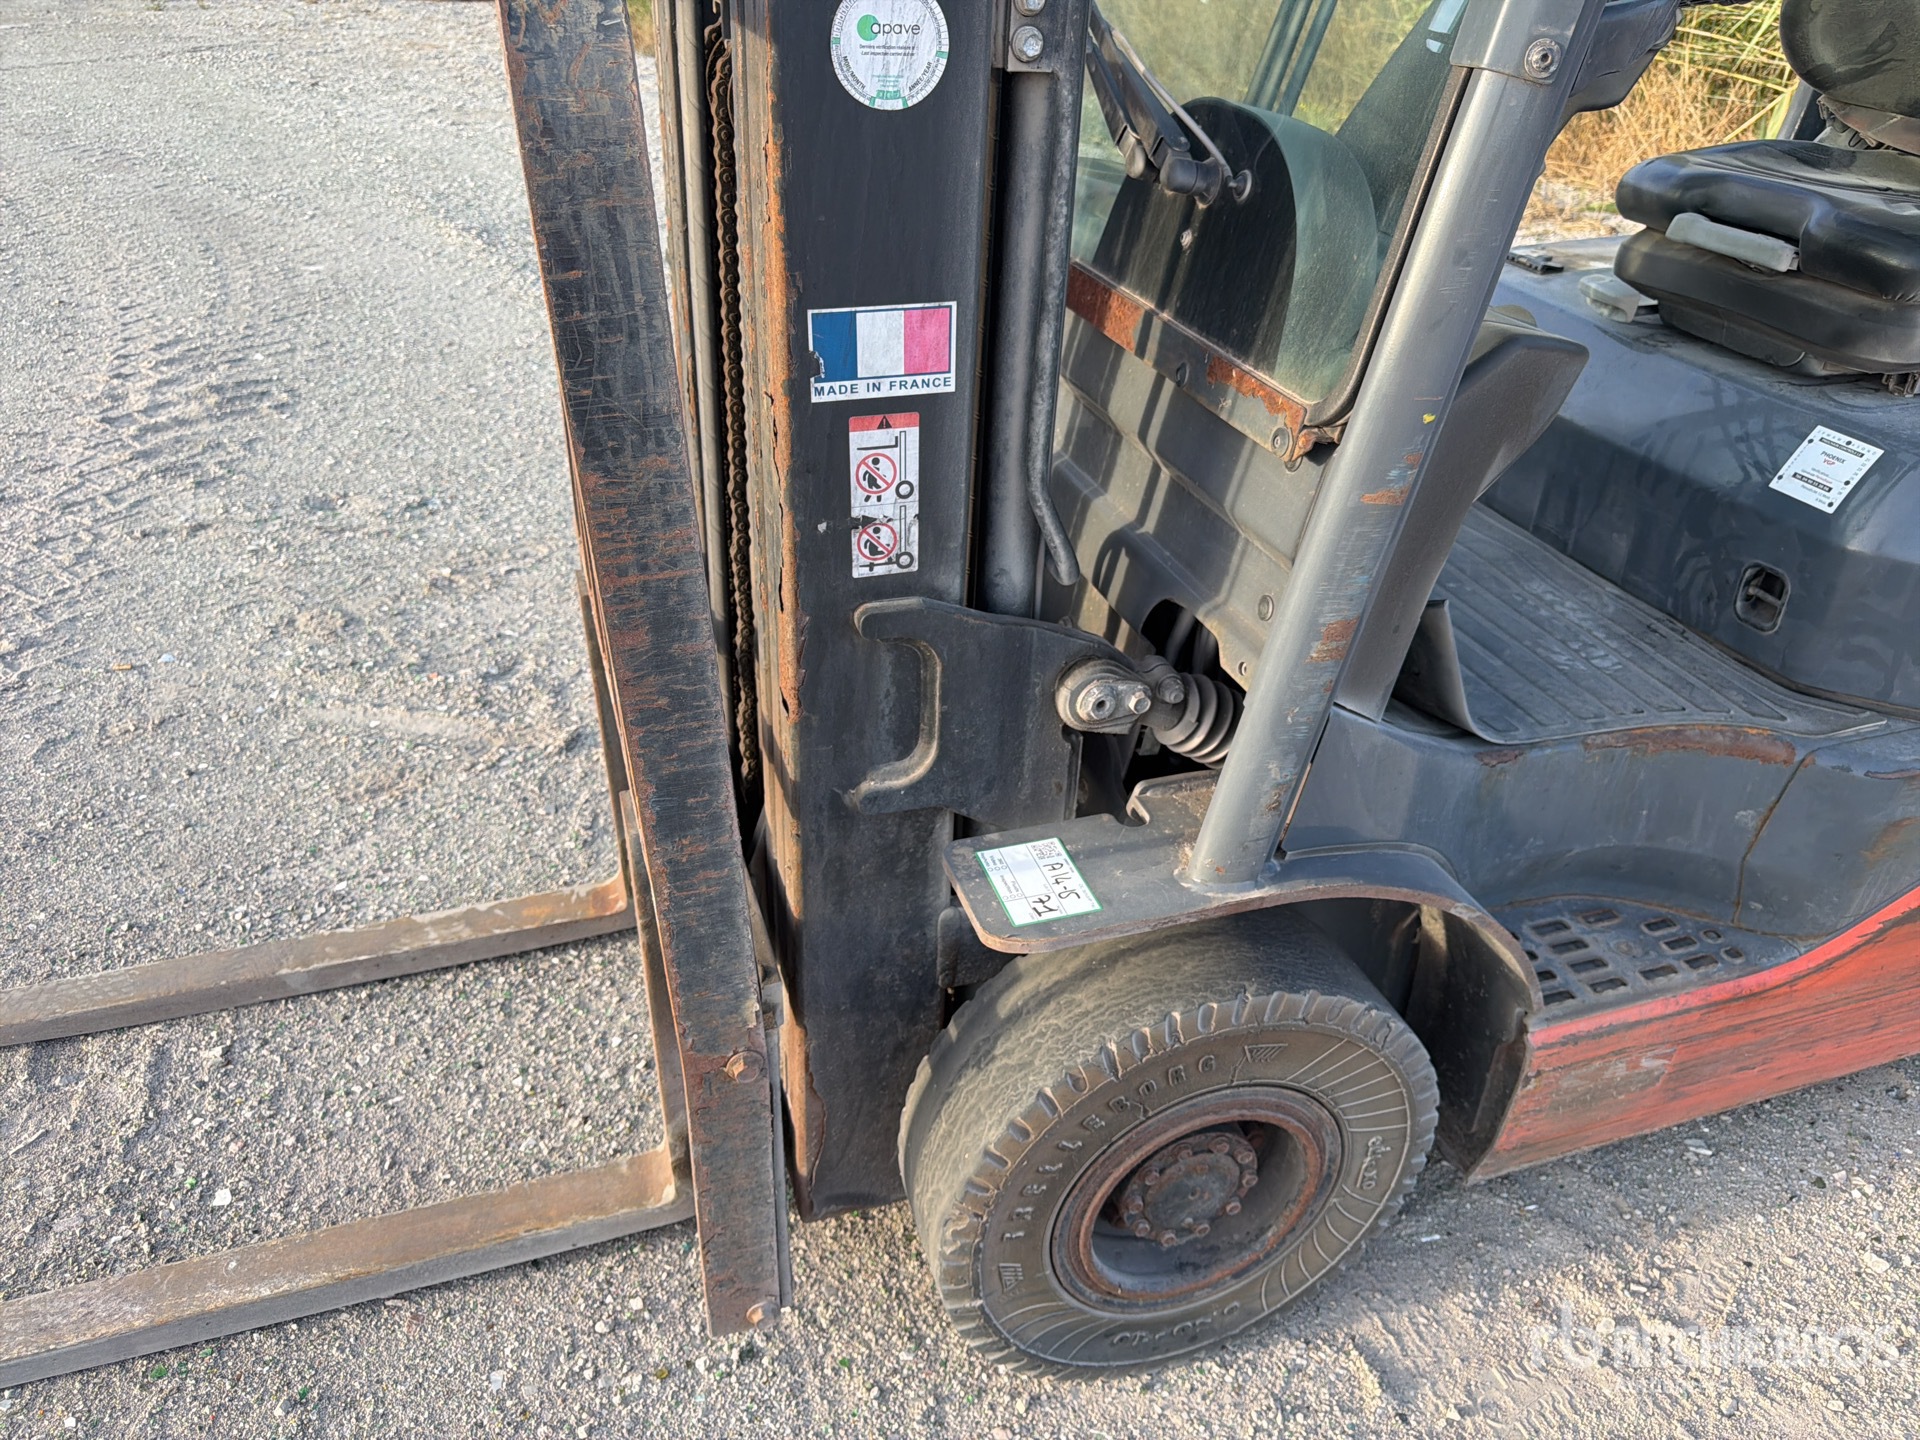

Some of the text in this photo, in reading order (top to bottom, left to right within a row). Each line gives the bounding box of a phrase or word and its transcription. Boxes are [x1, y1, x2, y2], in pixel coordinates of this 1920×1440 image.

[871, 22, 921, 37] apave
[814, 376, 952, 398] MADE IN FRANCE
[1820, 451, 1846, 464] PHOENIX
[1001, 1053, 1218, 1244] TRELLEBORG
